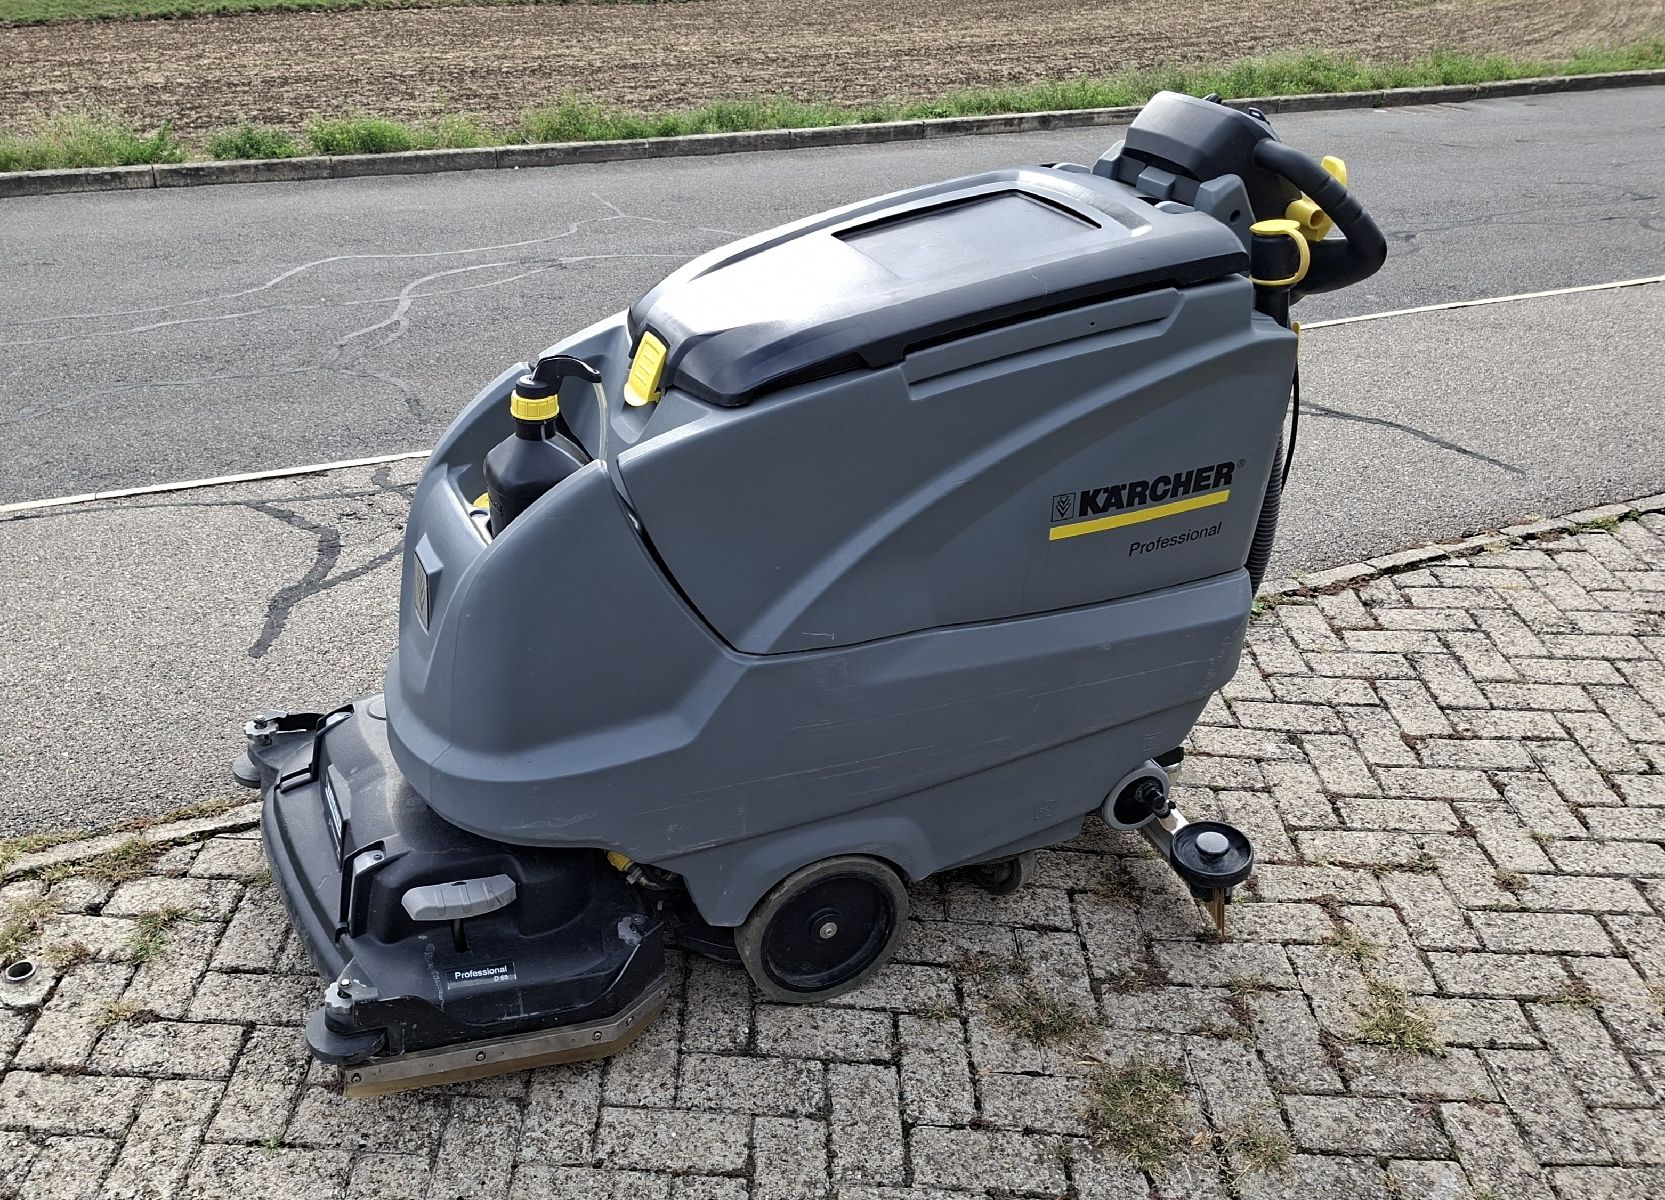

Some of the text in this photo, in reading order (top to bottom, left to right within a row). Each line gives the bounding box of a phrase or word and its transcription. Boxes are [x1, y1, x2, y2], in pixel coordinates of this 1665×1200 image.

[1078, 461, 1235, 517] KÄRCHER
[1128, 521, 1223, 557] Professional
[454, 965, 508, 980] Professional
